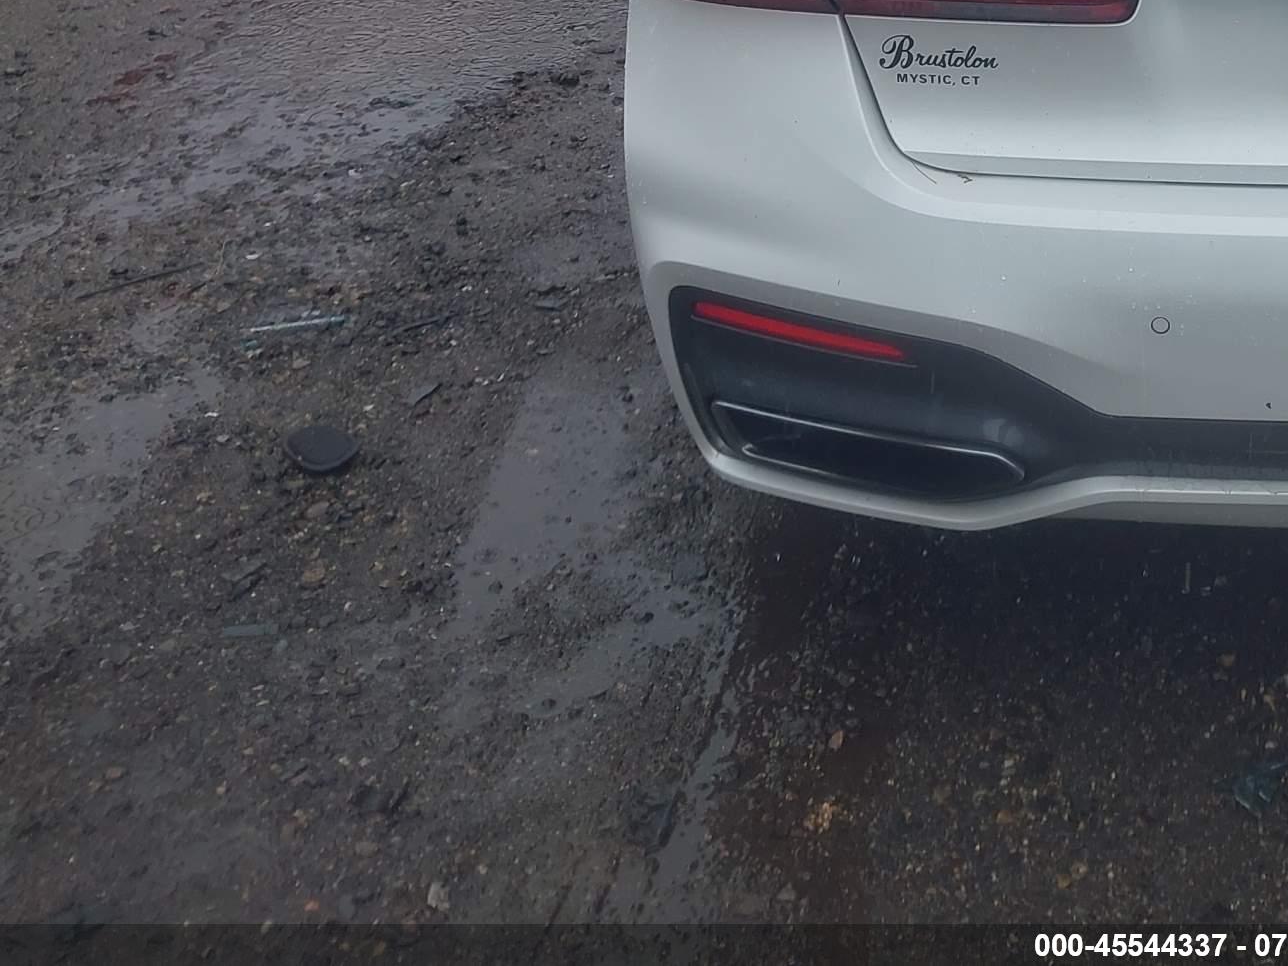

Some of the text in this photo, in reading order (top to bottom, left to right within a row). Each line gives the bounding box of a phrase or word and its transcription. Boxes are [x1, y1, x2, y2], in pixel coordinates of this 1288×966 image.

[878, 34, 999, 70] Brustolon
[896, 72, 981, 86] MYSTIC, CT
